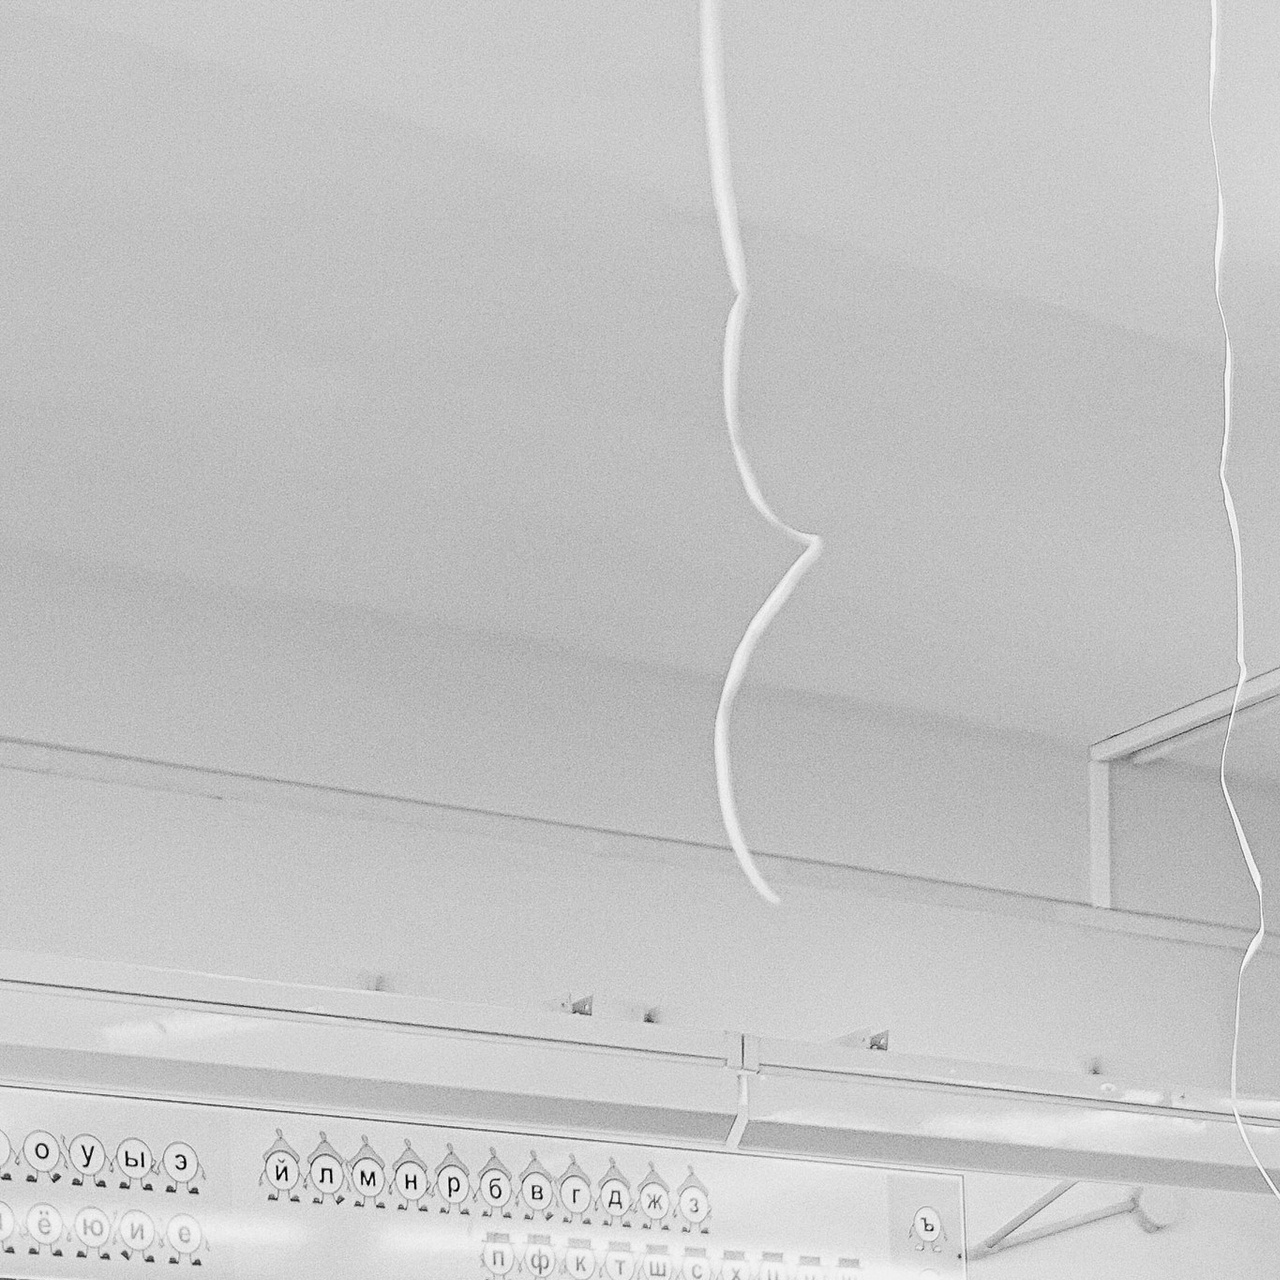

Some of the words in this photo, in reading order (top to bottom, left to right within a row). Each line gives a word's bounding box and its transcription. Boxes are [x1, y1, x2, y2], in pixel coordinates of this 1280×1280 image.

[34, 1142, 50, 1160] о
[80, 1144, 95, 1169] у
[124, 1150, 145, 1168] ы
[174, 1153, 188, 1171] э
[275, 1159, 289, 1182] й
[319, 1167, 334, 1185] л
[360, 1170, 377, 1187] м
[404, 1173, 418, 1191] н
[447, 1176, 461, 1198] р
[488, 1177, 503, 1200] б
[531, 1184, 544, 1201] в
[572, 1188, 581, 1204] г
[607, 1189, 623, 1210] д
[647, 1194, 663, 1210] ж
[689, 1197, 700, 1214] з
[37, 1209, 52, 1237] ё
[82, 1218, 104, 1238] ю
[130, 1222, 145, 1241] и
[177, 1226, 191, 1245] е
[920, 1217, 935, 1233] ъ
[492, 1251, 505, 1267] п
[530, 1250, 550, 1275] ф
[575, 1256, 587, 1273] к
[614, 1259, 626, 1276] т
[649, 1262, 667, 1278] ш
[691, 1264, 703, 1280] с
